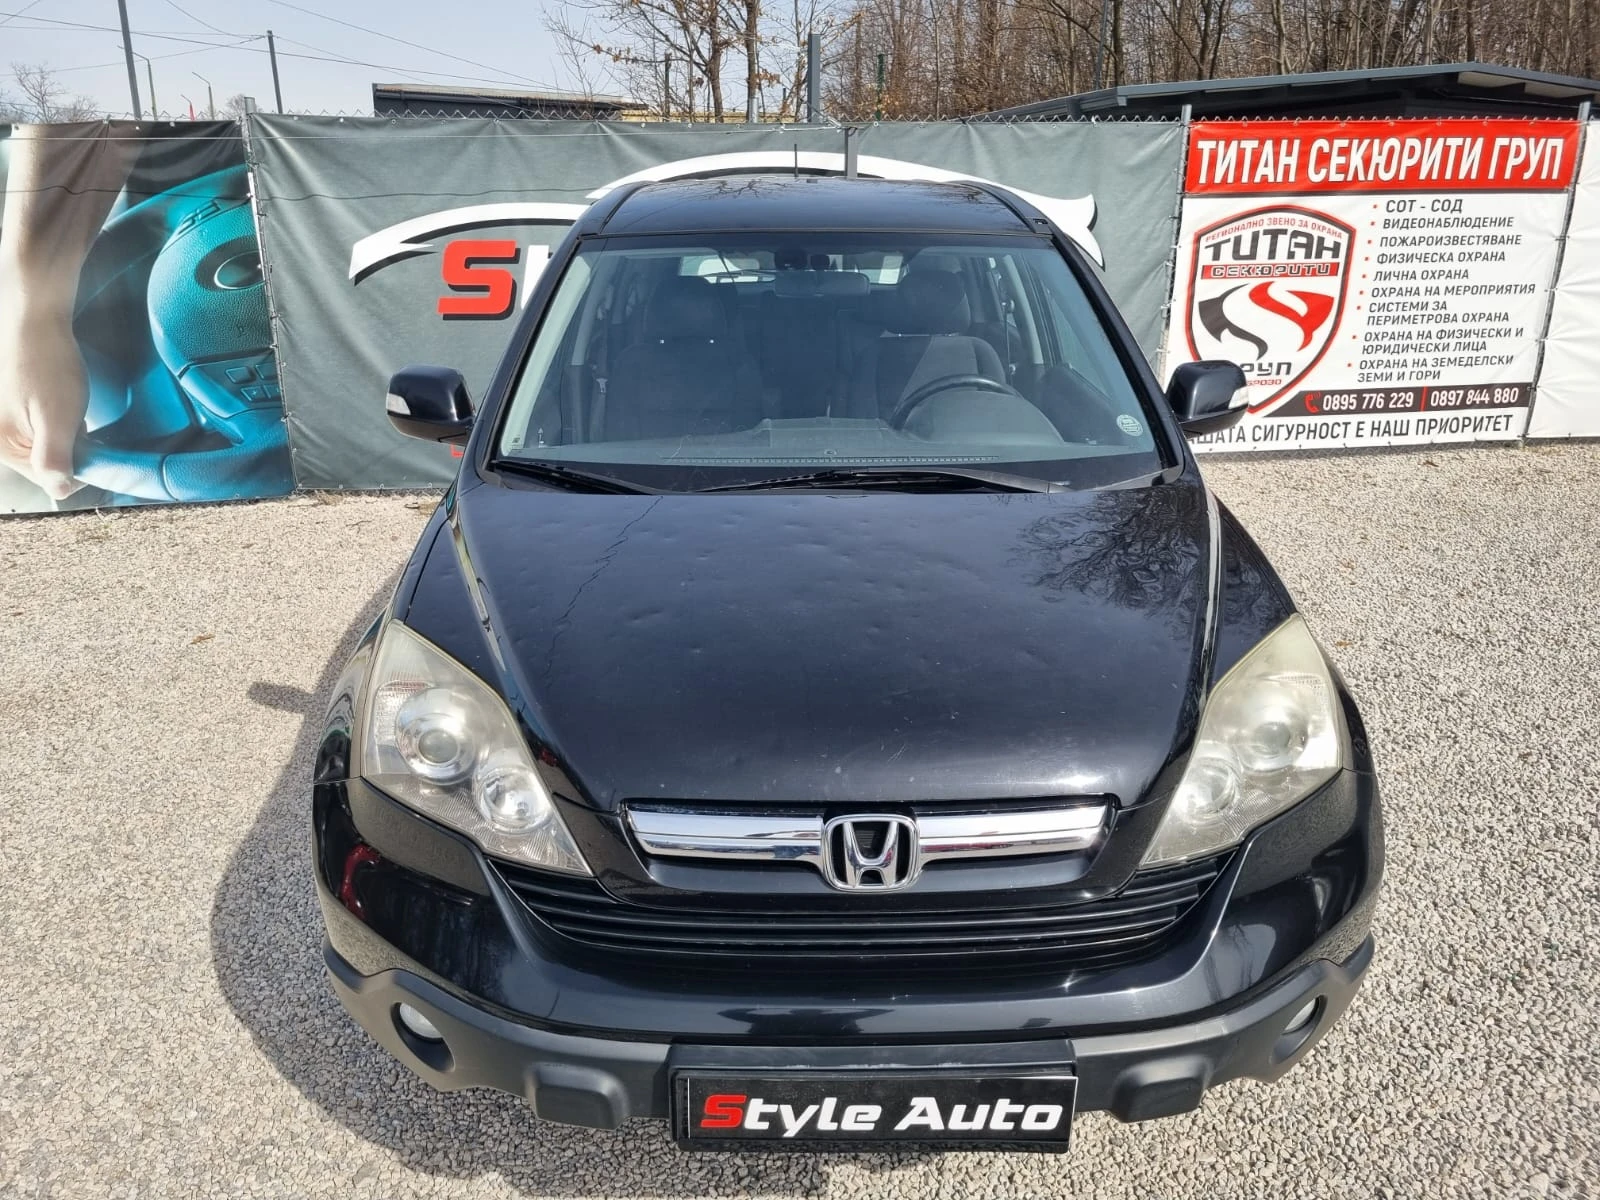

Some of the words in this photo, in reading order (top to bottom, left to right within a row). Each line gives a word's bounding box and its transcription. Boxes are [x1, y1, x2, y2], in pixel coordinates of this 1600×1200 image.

[1197, 139, 1300, 184] ТИТАН
[1308, 138, 1483, 183] СЕКЮРИТИ
[1488, 138, 1564, 180] ГРУП
[1386, 200, 1415, 212] СОТ
[1431, 199, 1463, 213] СОД
[1205, 219, 1264, 241] РЕГИОНАЛНО
[1267, 217, 1296, 226] ЗВЕНО
[1298, 219, 1309, 228] ЗА
[1311, 223, 1342, 239] ОХРАНА
[1383, 217, 1514, 229] ВИДЕОНАБЛЮДЕНИЕ
[1380, 235, 1522, 247] ПОЖАРОИЗВЕСТЯВАНЕ
[1377, 252, 1454, 264] ФИЗИЧЕСКА
[1458, 251, 1505, 262] ОХРАНА
[1373, 270, 1416, 281] ЛИЧНА
[1421, 269, 1469, 280] ОХРАНА
[1372, 287, 1420, 298] ОХРАНА
[1425, 286, 1440, 296] НА
[1444, 284, 1535, 295] МЕРОПРИЯТИЯ
[1369, 302, 1428, 312] СИСТЕМИ
[1432, 301, 1447, 311] ЗА
[1367, 314, 1458, 325] ПЕРИМЕТРОВА
[1462, 313, 1509, 323] ОХРАНА
[1364, 331, 1412, 341] ОХРАНА
[1417, 330, 1432, 339] НА
[1436, 328, 1511, 339] ФИЗИЧЕСКИ
[1515, 328, 1523, 337] И
[1362, 343, 1449, 355] ЮРИДИЧЕСКИ
[1453, 342, 1487, 352] ЛИЦА
[1240, 362, 1292, 376] РУП
[1360, 359, 1408, 369] ОХРАНА
[1412, 358, 1427, 368] НА
[1431, 355, 1513, 367] ЗЕМЕДЕЛСКИ
[1357, 371, 1393, 383] ЗЕМИ
[1396, 371, 1405, 381] И
[1409, 369, 1441, 381] ГОРИ
[1322, 394, 1357, 411] 0895
[1361, 392, 1384, 410] 776
[1388, 391, 1414, 408] 229
[1430, 390, 1463, 406] 0897
[1466, 389, 1490, 405] 844
[1493, 387, 1519, 404] 880
[1252, 418, 1352, 442] СИГУРНОСТ
[1355, 419, 1365, 438] Е
[1370, 416, 1408, 437] НАШ
[1416, 414, 1513, 435] ПРИОРИТЕТ
[700, 1095, 881, 1138] Style
[894, 1097, 1063, 1131] Auto
